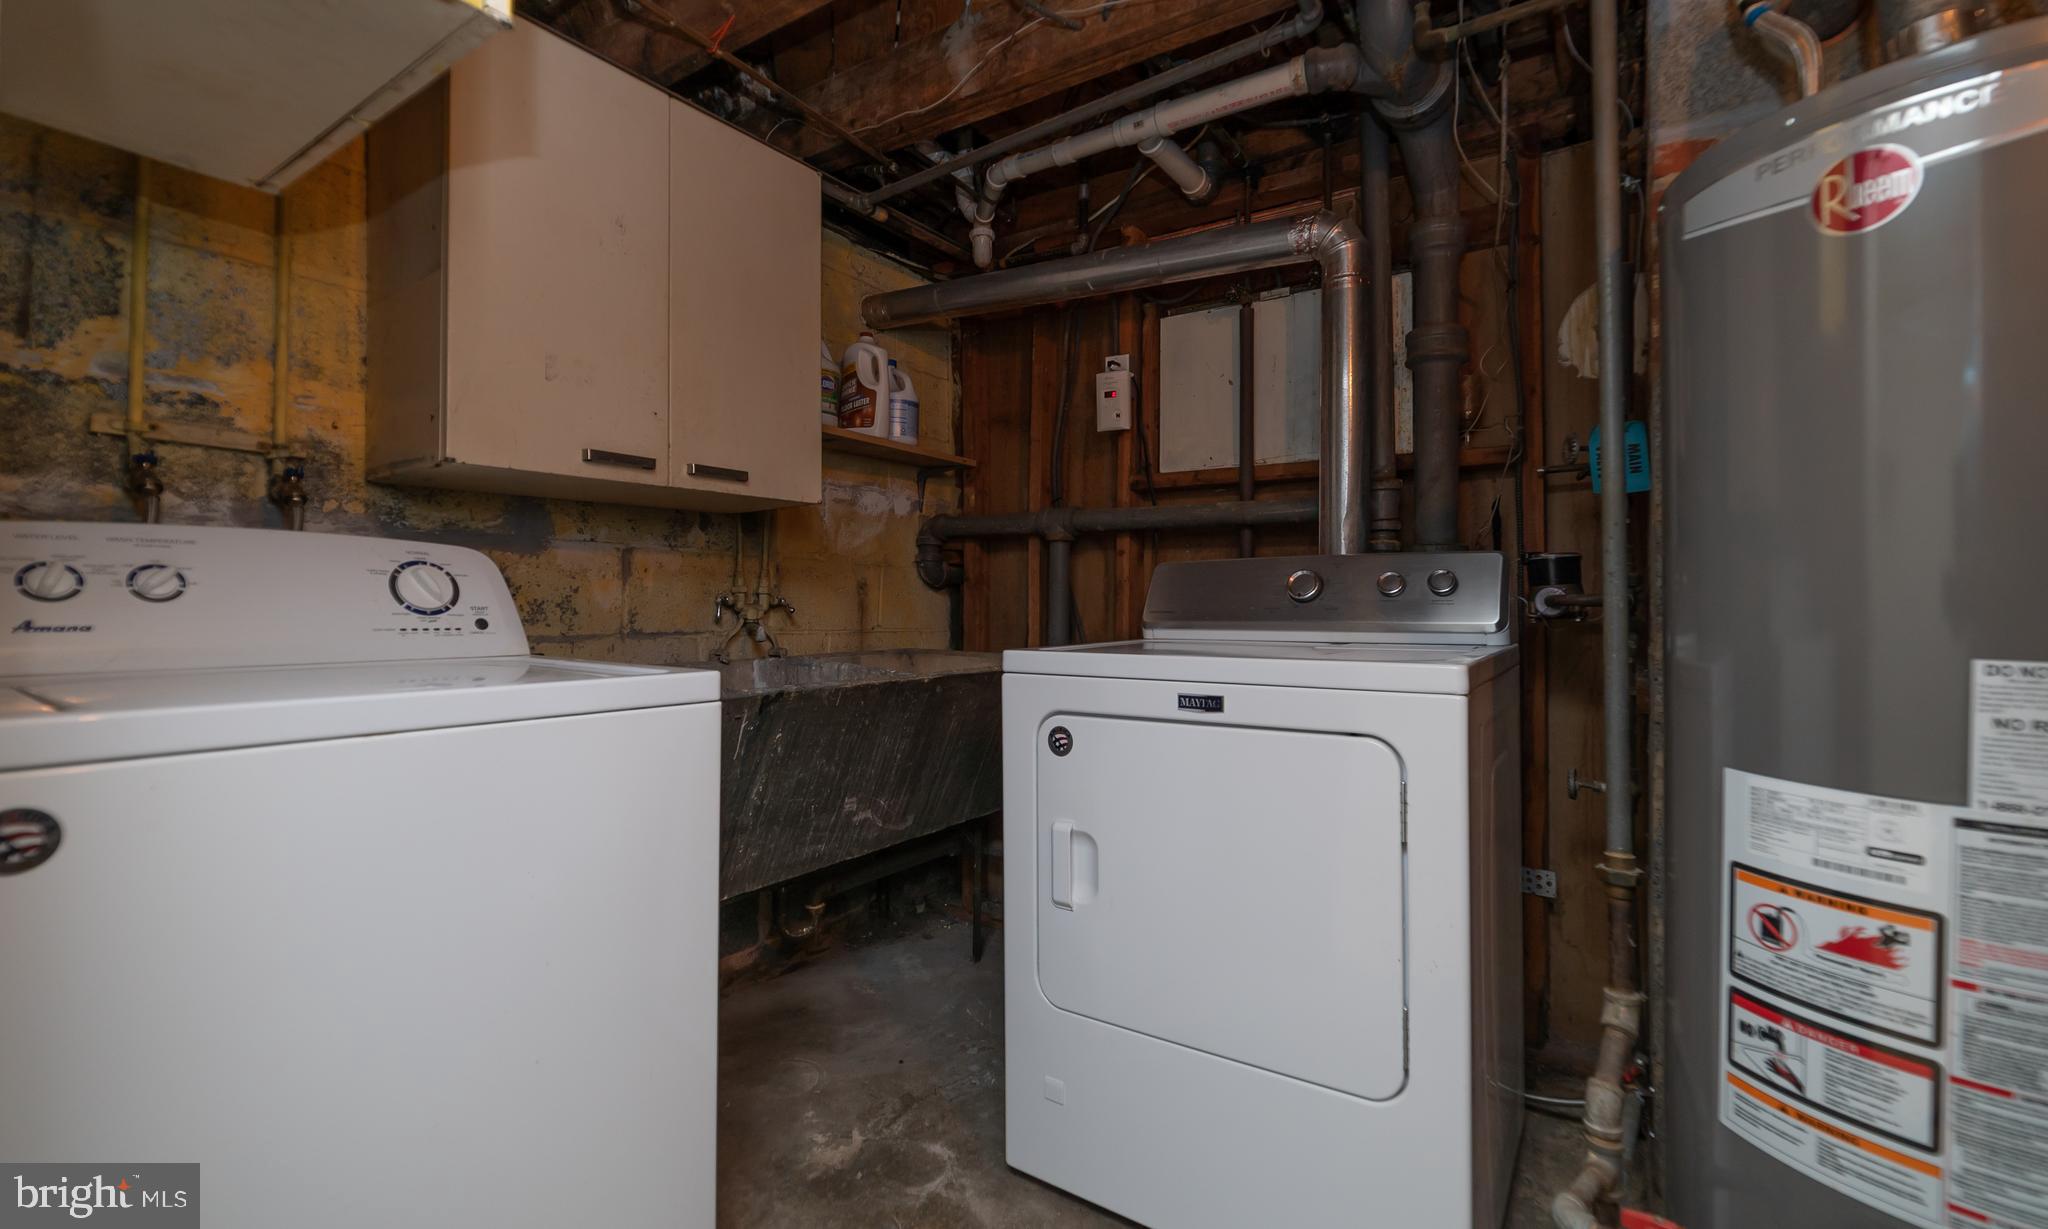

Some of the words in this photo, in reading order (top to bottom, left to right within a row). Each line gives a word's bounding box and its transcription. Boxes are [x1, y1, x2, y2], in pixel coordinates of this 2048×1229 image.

[1820, 152, 1911, 227] Rheem
[1628, 443, 1643, 474] MAIN
[12, 619, 94, 634] Amana
[1180, 697, 1221, 709] MAYTAG
[1992, 718, 2026, 732] NO
